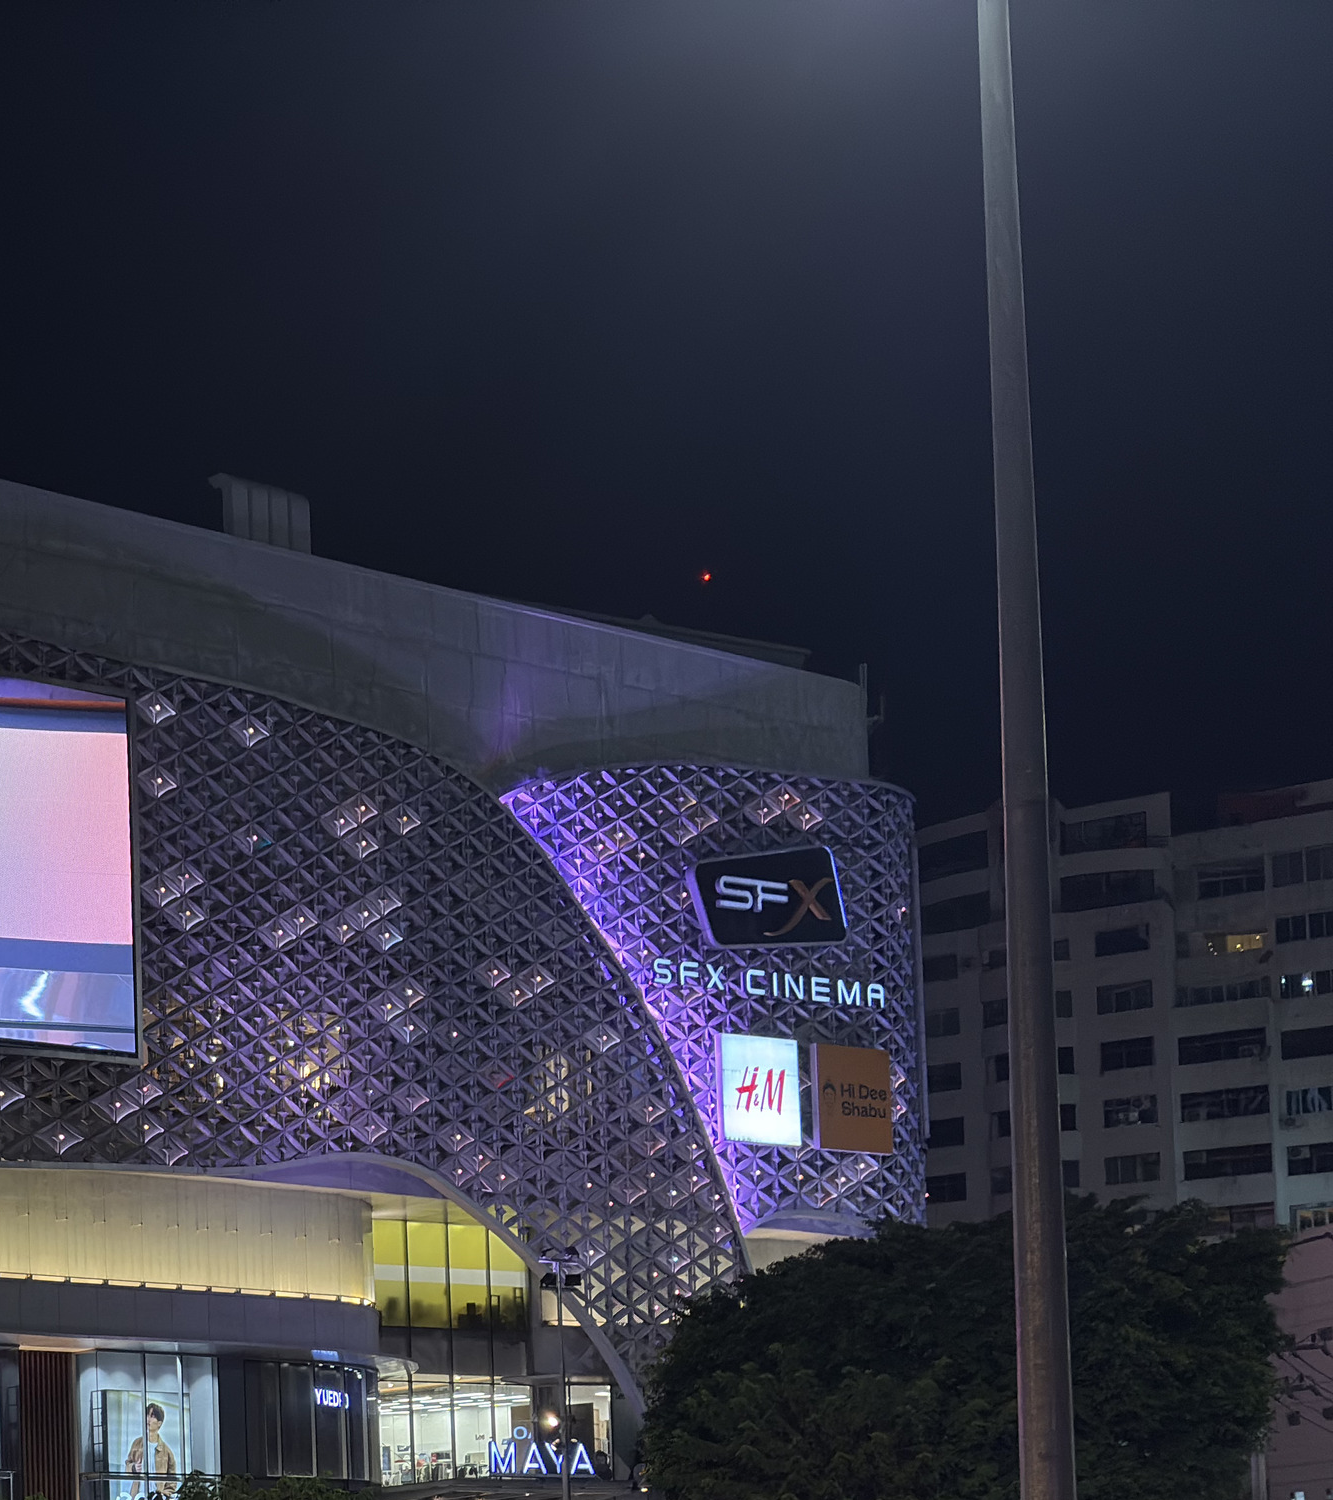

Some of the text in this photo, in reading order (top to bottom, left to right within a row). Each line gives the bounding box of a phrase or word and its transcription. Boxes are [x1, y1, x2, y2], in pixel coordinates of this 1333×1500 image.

[716, 875, 833, 937] SFX
[653, 958, 885, 1008] SFX CINEMA
[735, 1066, 786, 1115] H&M
[841, 1083, 887, 1102] Hi Dee
[841, 1102, 887, 1118] Shabu
[314, 1388, 350, 1409] YUED
[489, 1440, 596, 1475] MAYA
